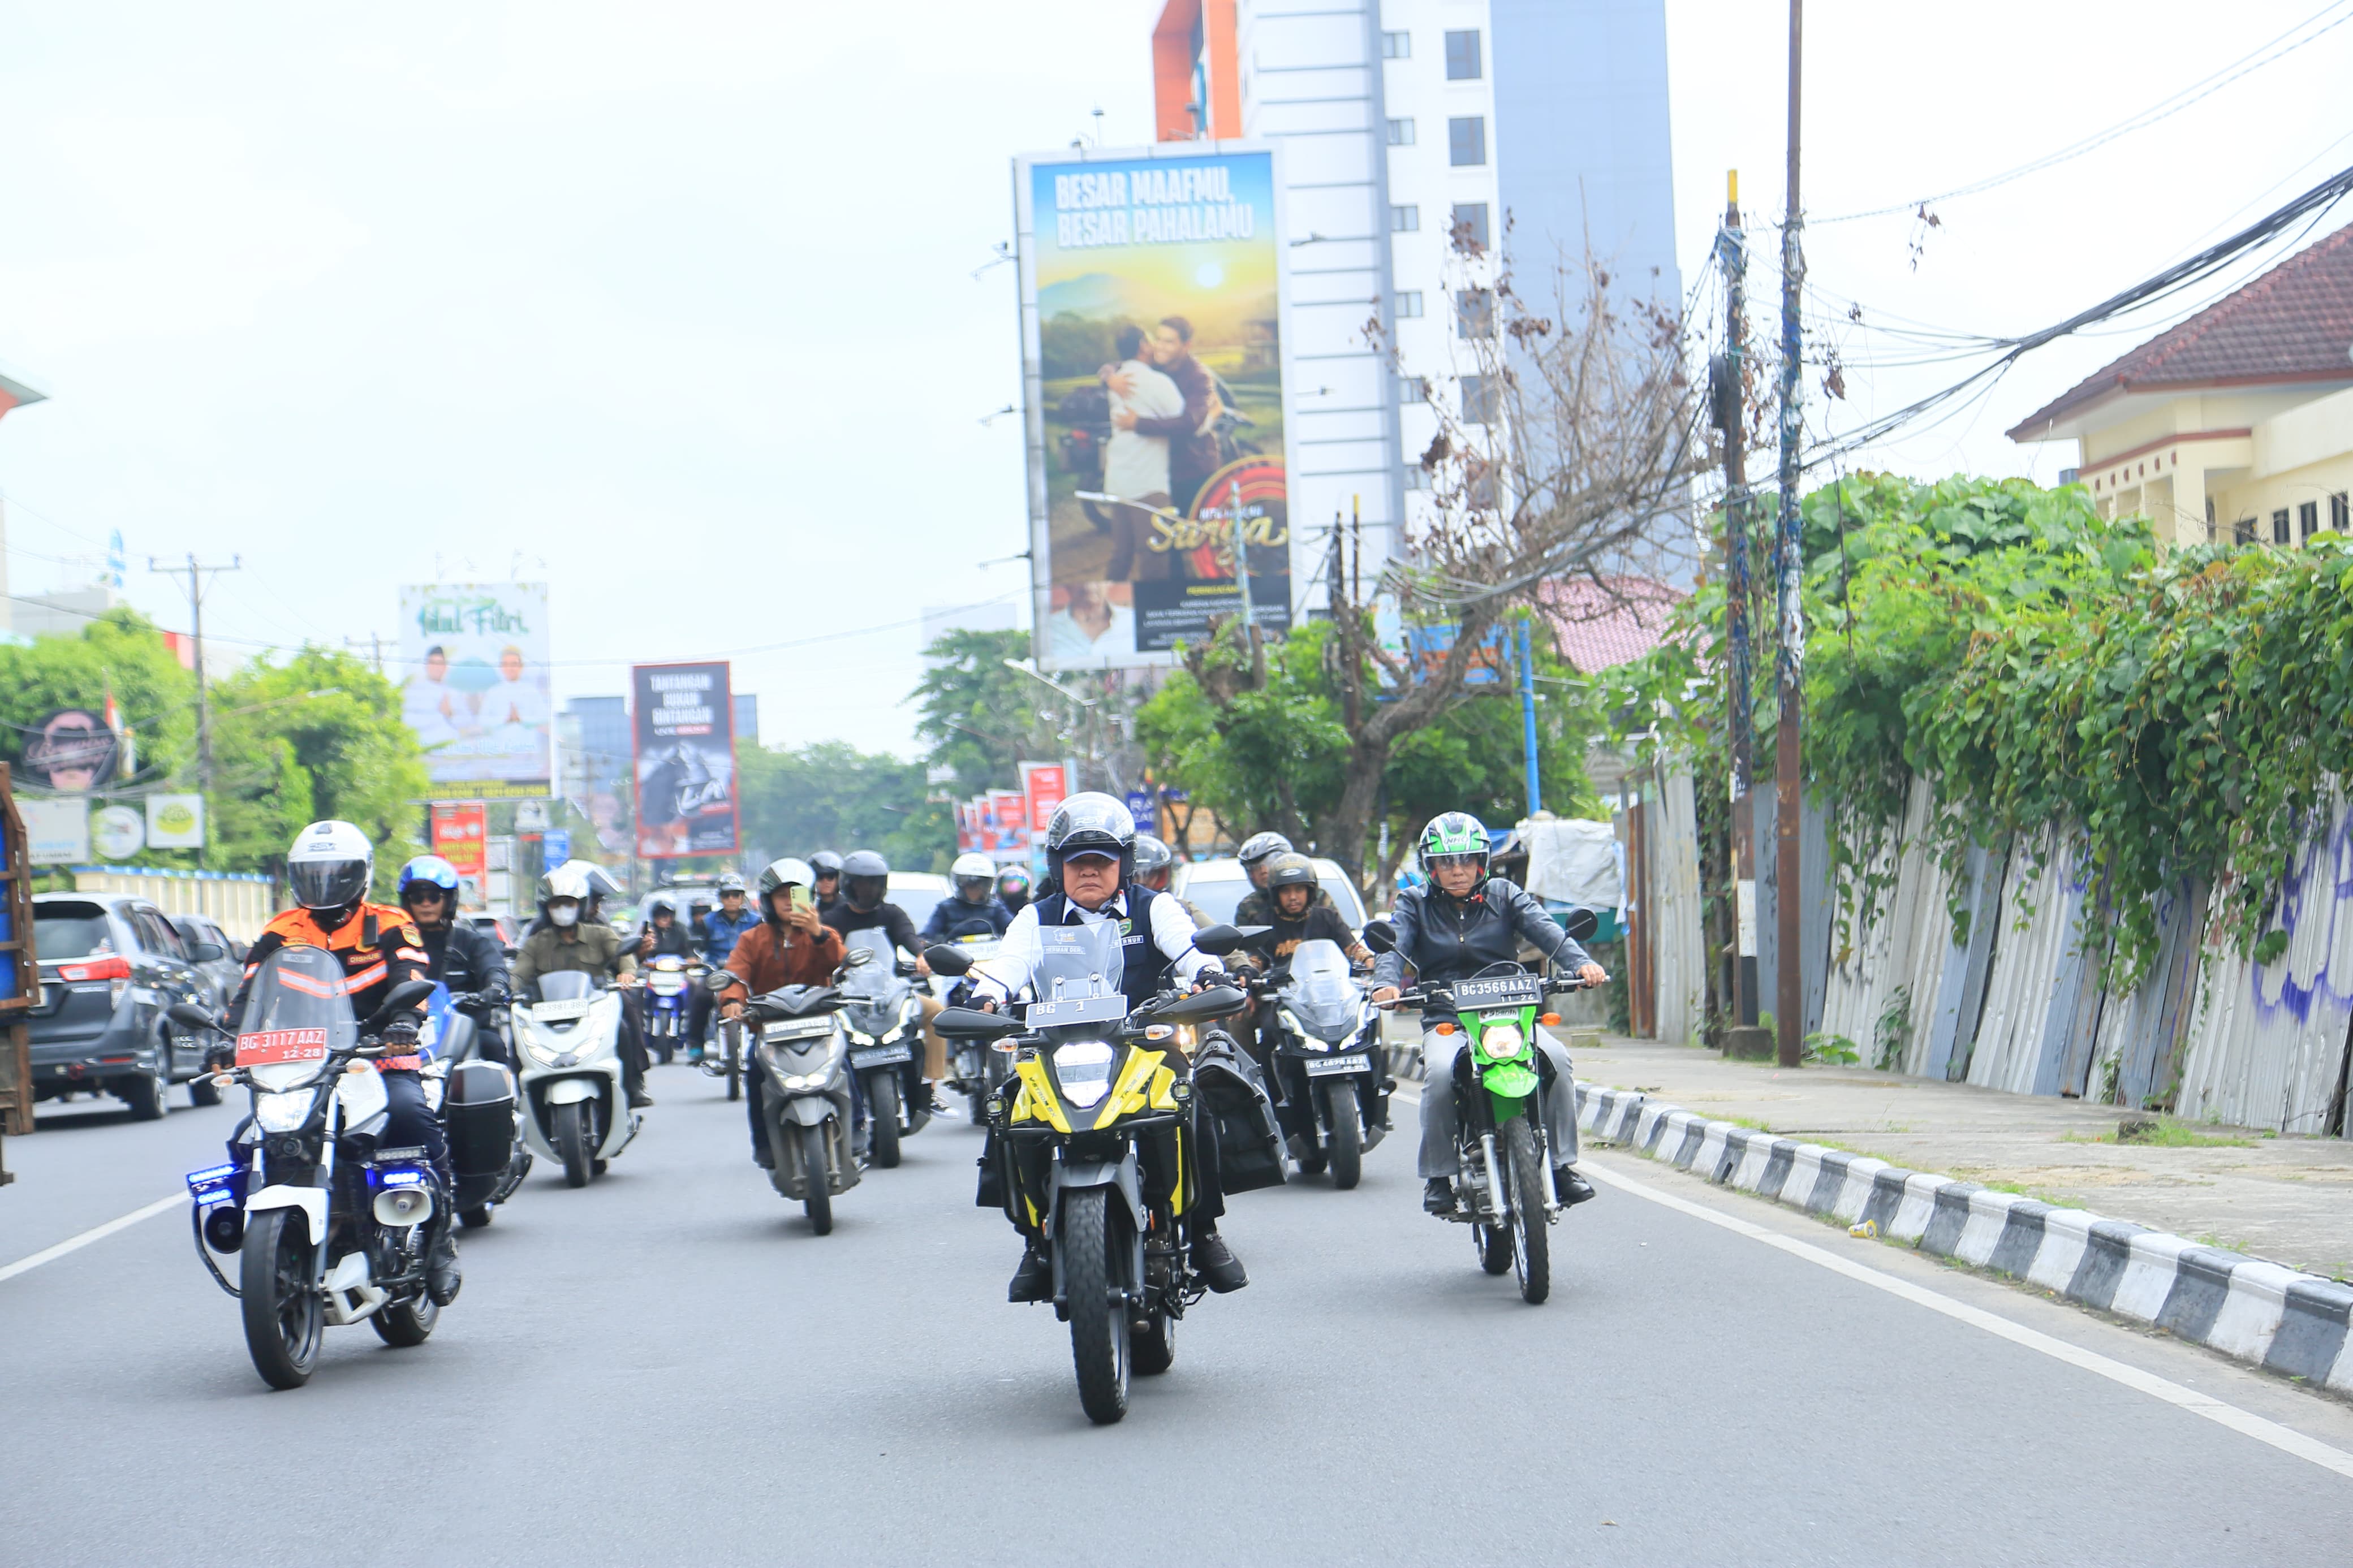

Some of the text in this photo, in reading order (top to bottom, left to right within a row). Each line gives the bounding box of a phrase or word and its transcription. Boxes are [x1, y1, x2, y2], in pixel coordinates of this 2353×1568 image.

[1055, 166, 1236, 211] BESAR MAAFMU,
[1057, 203, 1253, 248] BESAR PAHALAMU
[650, 673, 713, 693] TANTANGAN
[1036, 1001, 1085, 1016] BG 1
[240, 1030, 324, 1050] BG 3117 AAZ
[282, 1048, 322, 1059] 12-28
